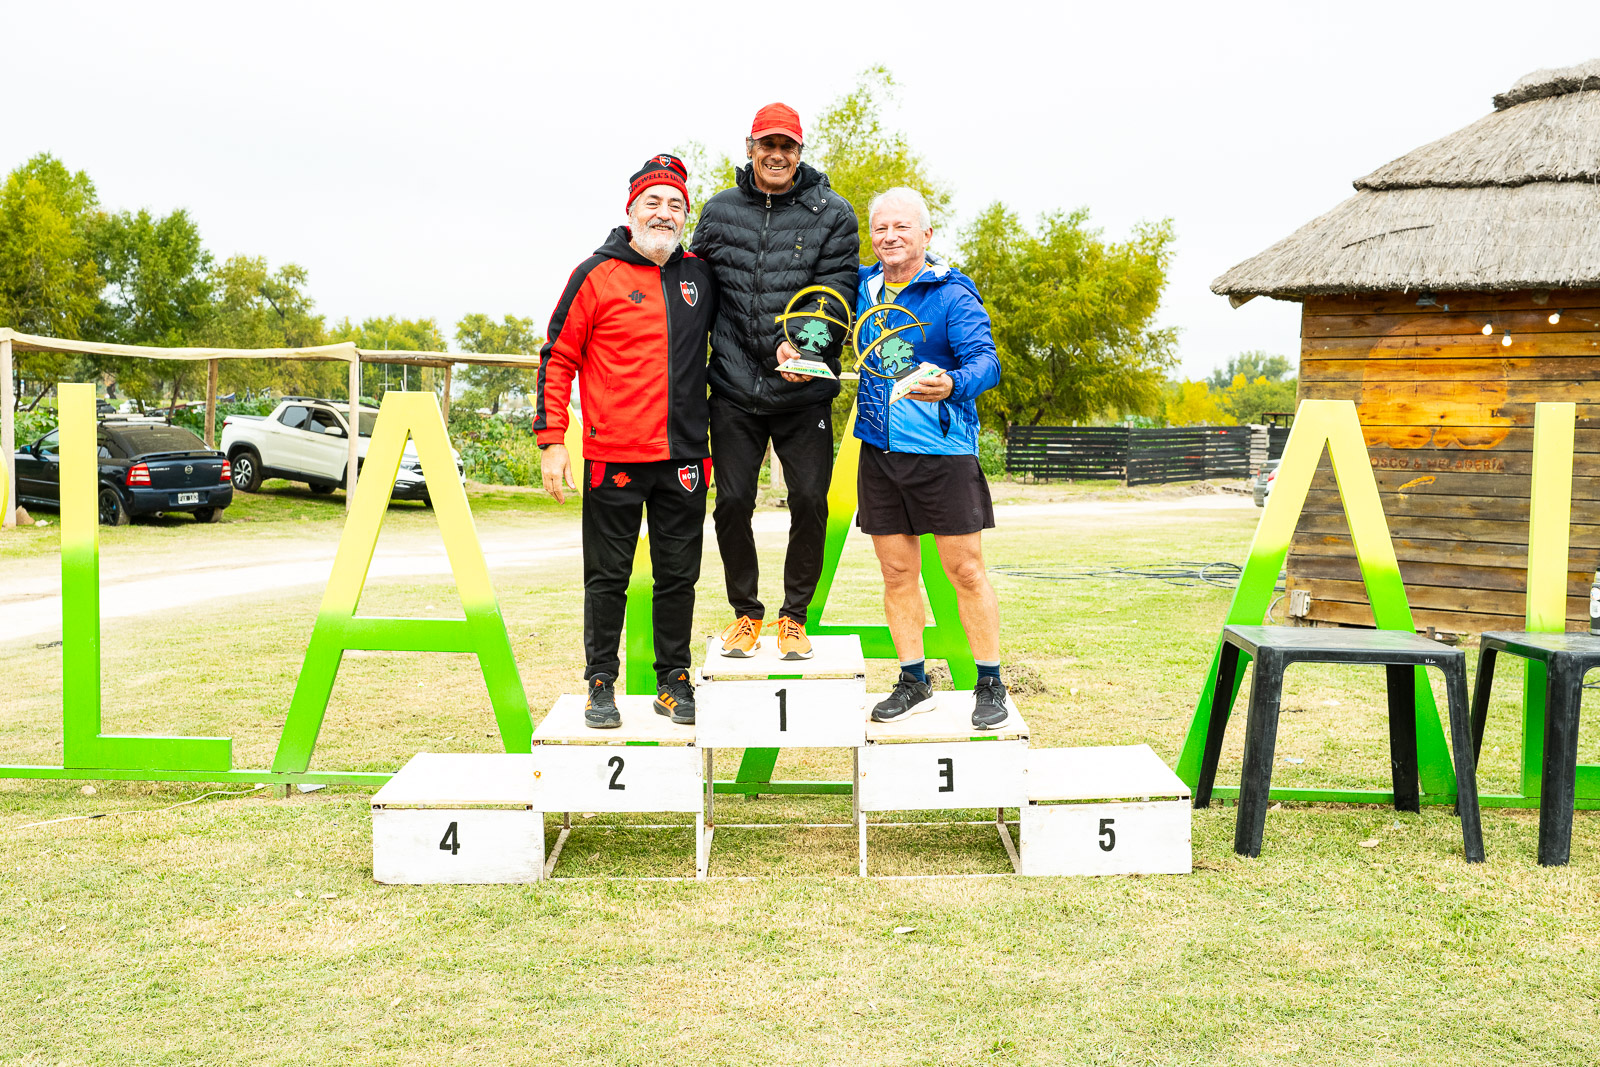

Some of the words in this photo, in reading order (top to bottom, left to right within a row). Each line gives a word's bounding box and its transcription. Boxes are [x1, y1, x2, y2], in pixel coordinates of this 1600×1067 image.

[682, 472, 696, 481] NOB
[775, 689, 787, 732] 1
[607, 755, 626, 791] 2
[937, 757, 954, 793] 3
[439, 821, 461, 856] 4
[1098, 818, 1116, 852] 5
